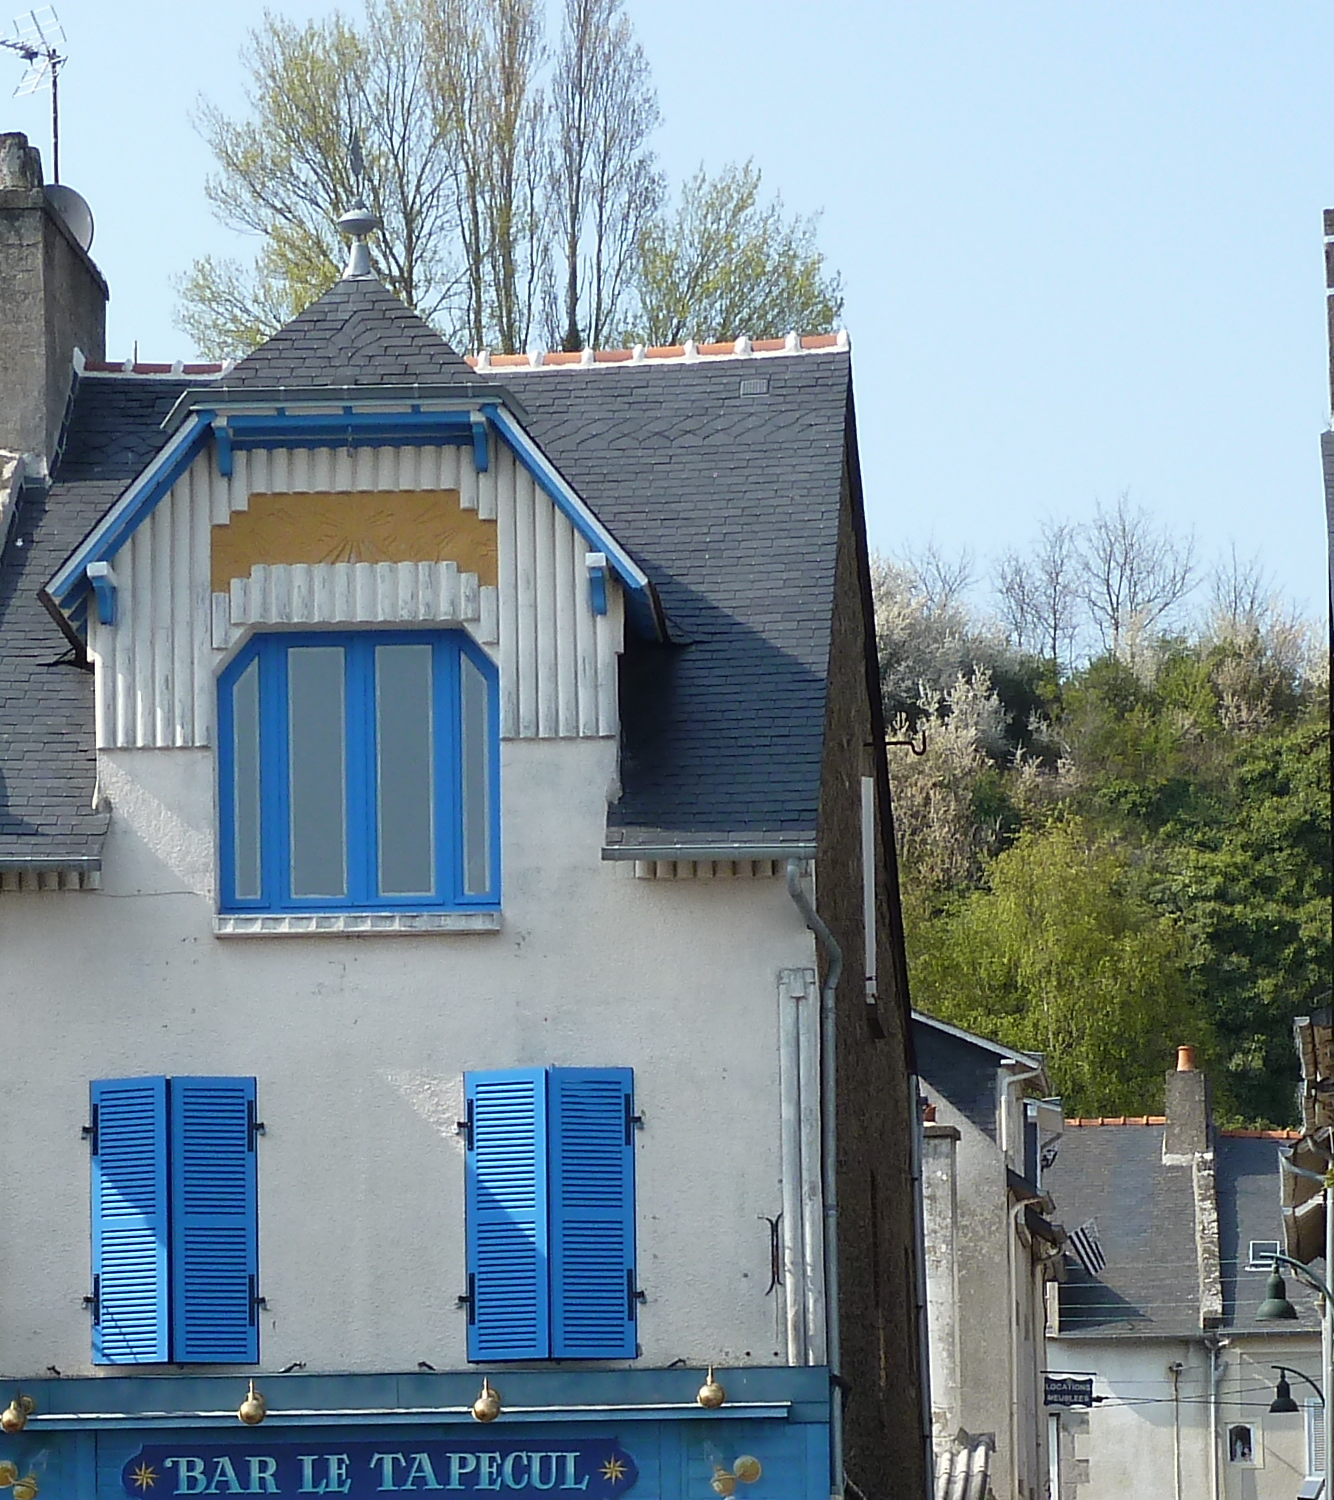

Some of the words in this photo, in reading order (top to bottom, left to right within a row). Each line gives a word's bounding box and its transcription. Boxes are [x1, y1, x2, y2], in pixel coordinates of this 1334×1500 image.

[165, 1456, 278, 1495] BAR
[297, 1453, 352, 1494] LE
[370, 1451, 590, 1491] TAPECUL
